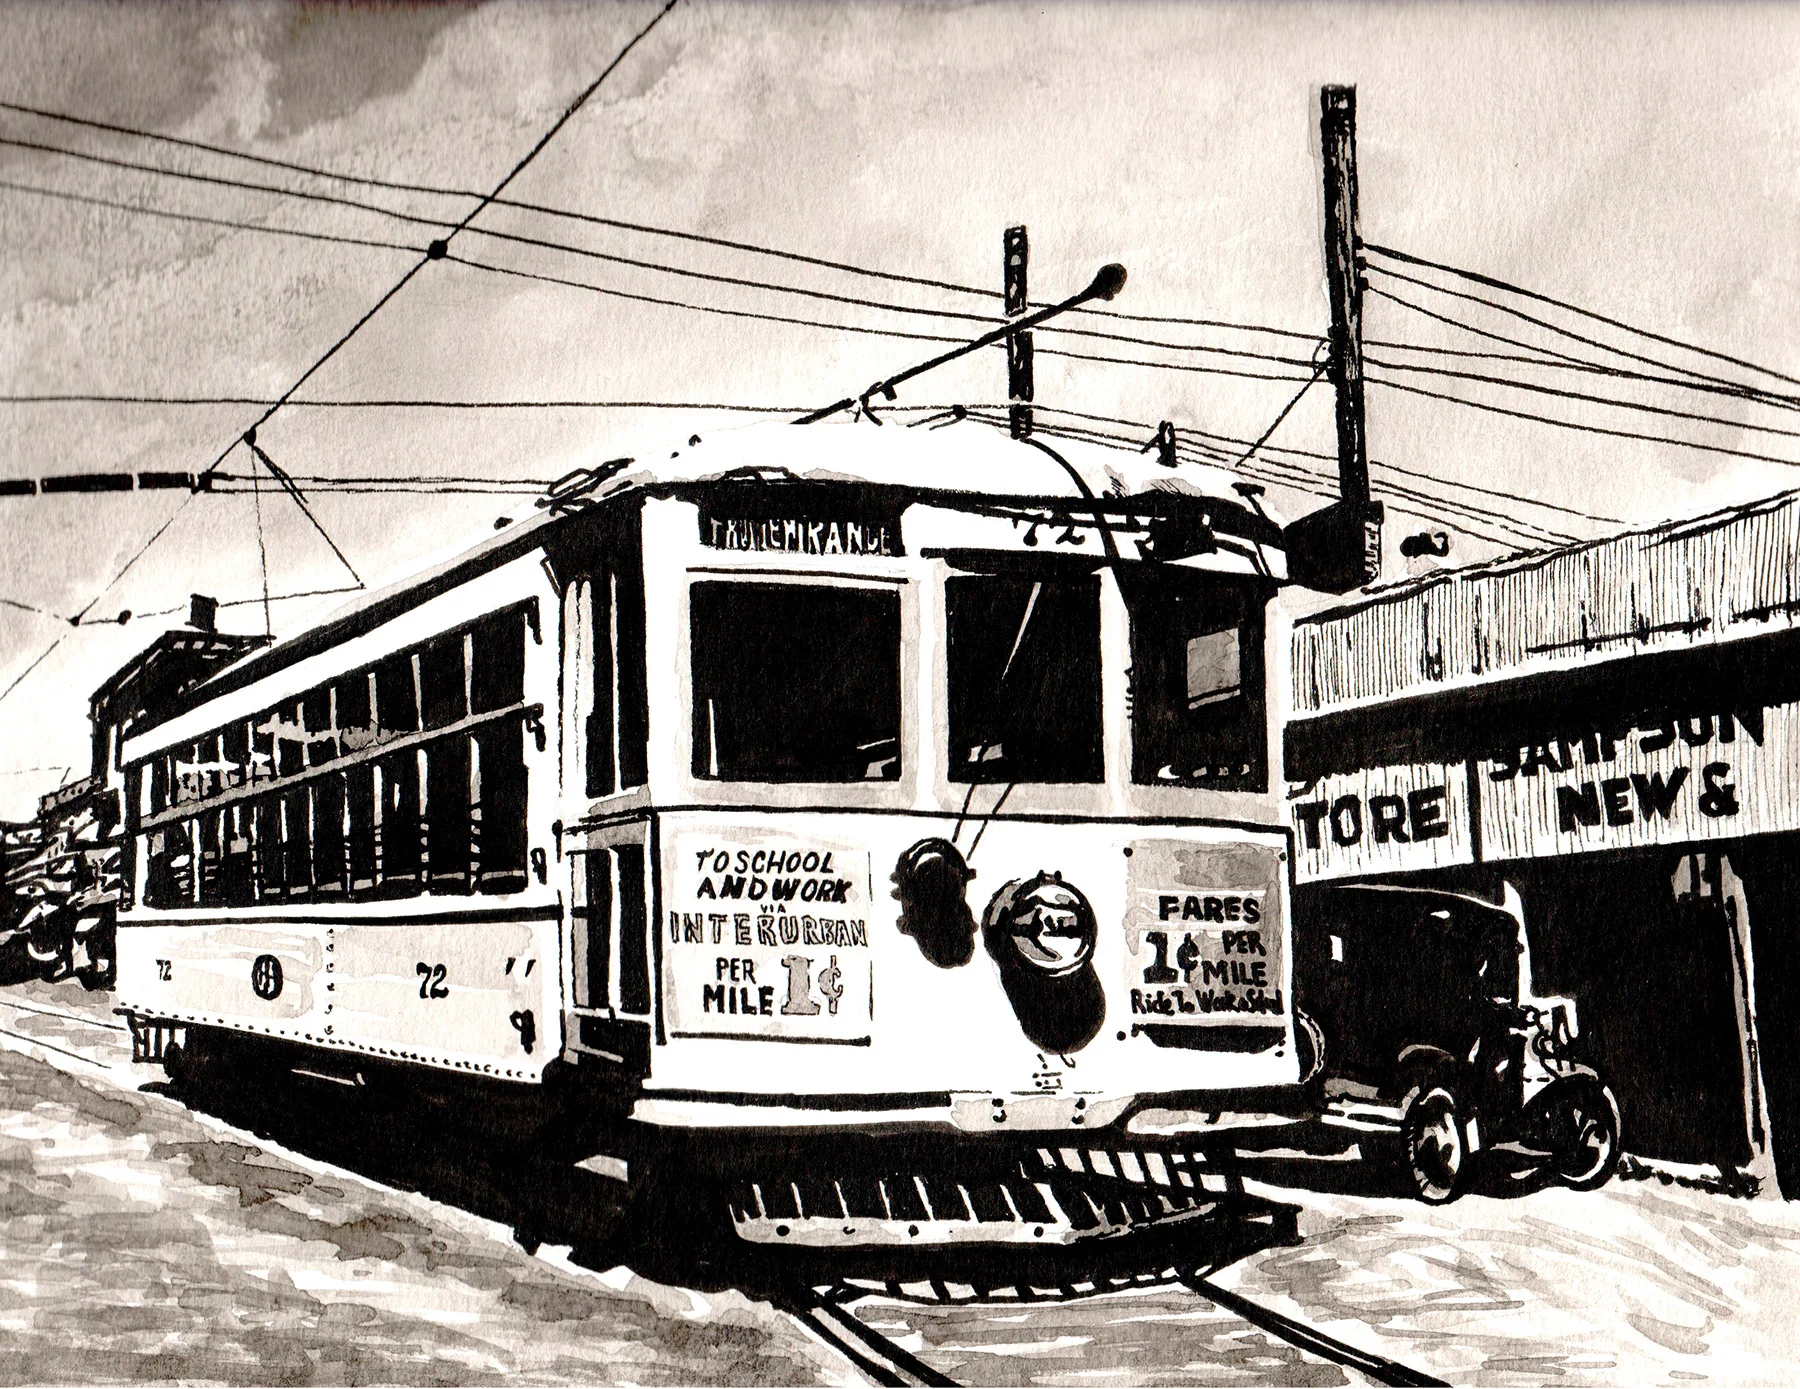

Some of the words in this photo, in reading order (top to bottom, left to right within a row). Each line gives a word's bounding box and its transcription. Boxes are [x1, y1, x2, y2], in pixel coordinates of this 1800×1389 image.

[1555, 765, 1691, 835] NEW
[1698, 761, 1740, 818] &
[696, 848, 730, 873] TO
[734, 850, 834, 874] SCHOOL
[697, 874, 768, 901] AND
[771, 878, 853, 904] WORK
[1158, 895, 1261, 925] FARES
[670, 911, 869, 948] INTERURBAN
[1221, 930, 1267, 957] PER
[155, 958, 172, 981] 72
[415, 961, 450, 1000] 72
[716, 957, 757, 985] PER
[1201, 960, 1268, 988] MILE
[703, 984, 774, 1017] MILE
[1130, 988, 1175, 1016] Ride
